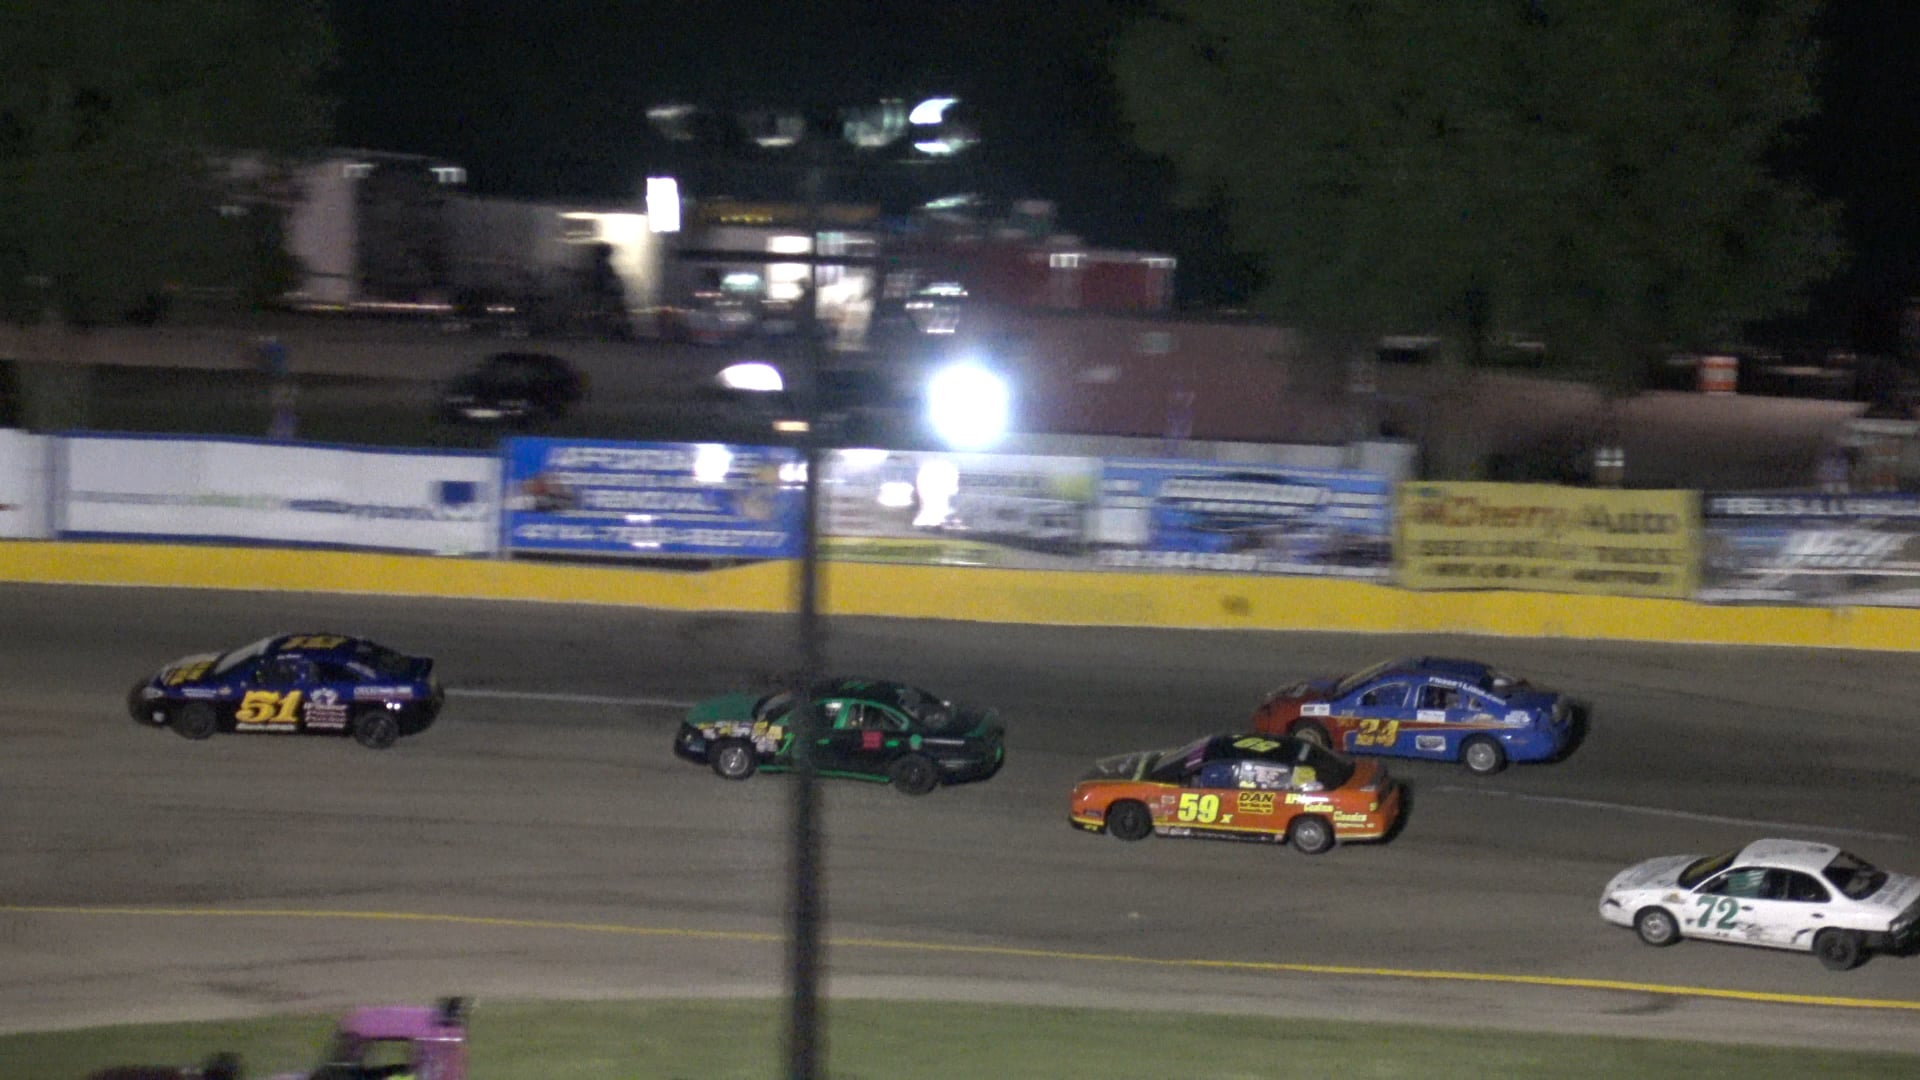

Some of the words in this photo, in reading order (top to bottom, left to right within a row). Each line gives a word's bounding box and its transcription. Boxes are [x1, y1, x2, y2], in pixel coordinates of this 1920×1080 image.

[235, 690, 302, 723] 51
[1355, 719, 1400, 748] 24
[1177, 792, 1220, 824] 59
[1239, 793, 1274, 803] DAN
[1696, 895, 1741, 929] 72
